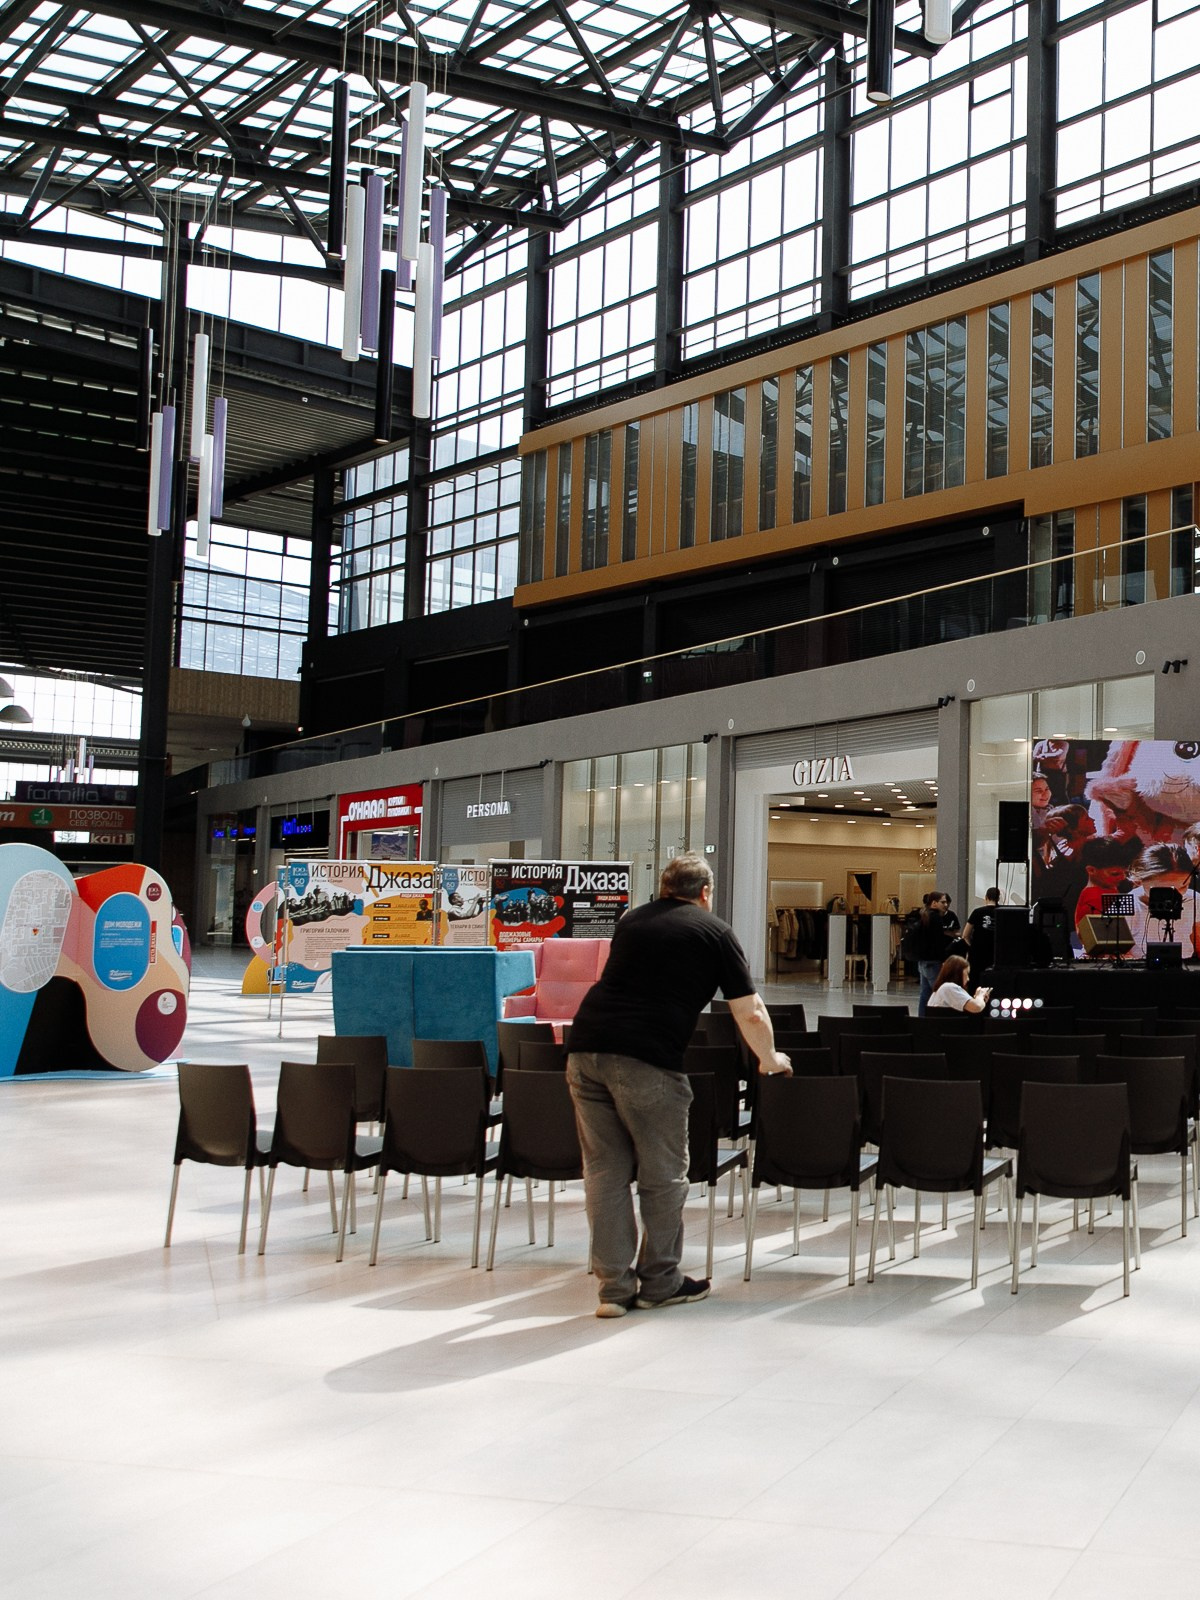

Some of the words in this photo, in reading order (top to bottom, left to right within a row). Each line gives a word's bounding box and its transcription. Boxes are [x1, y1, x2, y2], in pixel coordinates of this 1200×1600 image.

[793, 755, 855, 786] GIZIA
[27, 785, 99, 801] familia
[69, 809, 124, 821] ПОЗВОЛЬ
[348, 799, 386, 822] O'HARA
[466, 801, 511, 818] PERSONA
[90, 832, 124, 844] kari
[311, 865, 364, 878] ИСТОРИЯ
[366, 865, 433, 892] Джаза
[511, 865, 563, 879] ИСТОРИЯ
[563, 866, 629, 894] Джаза
